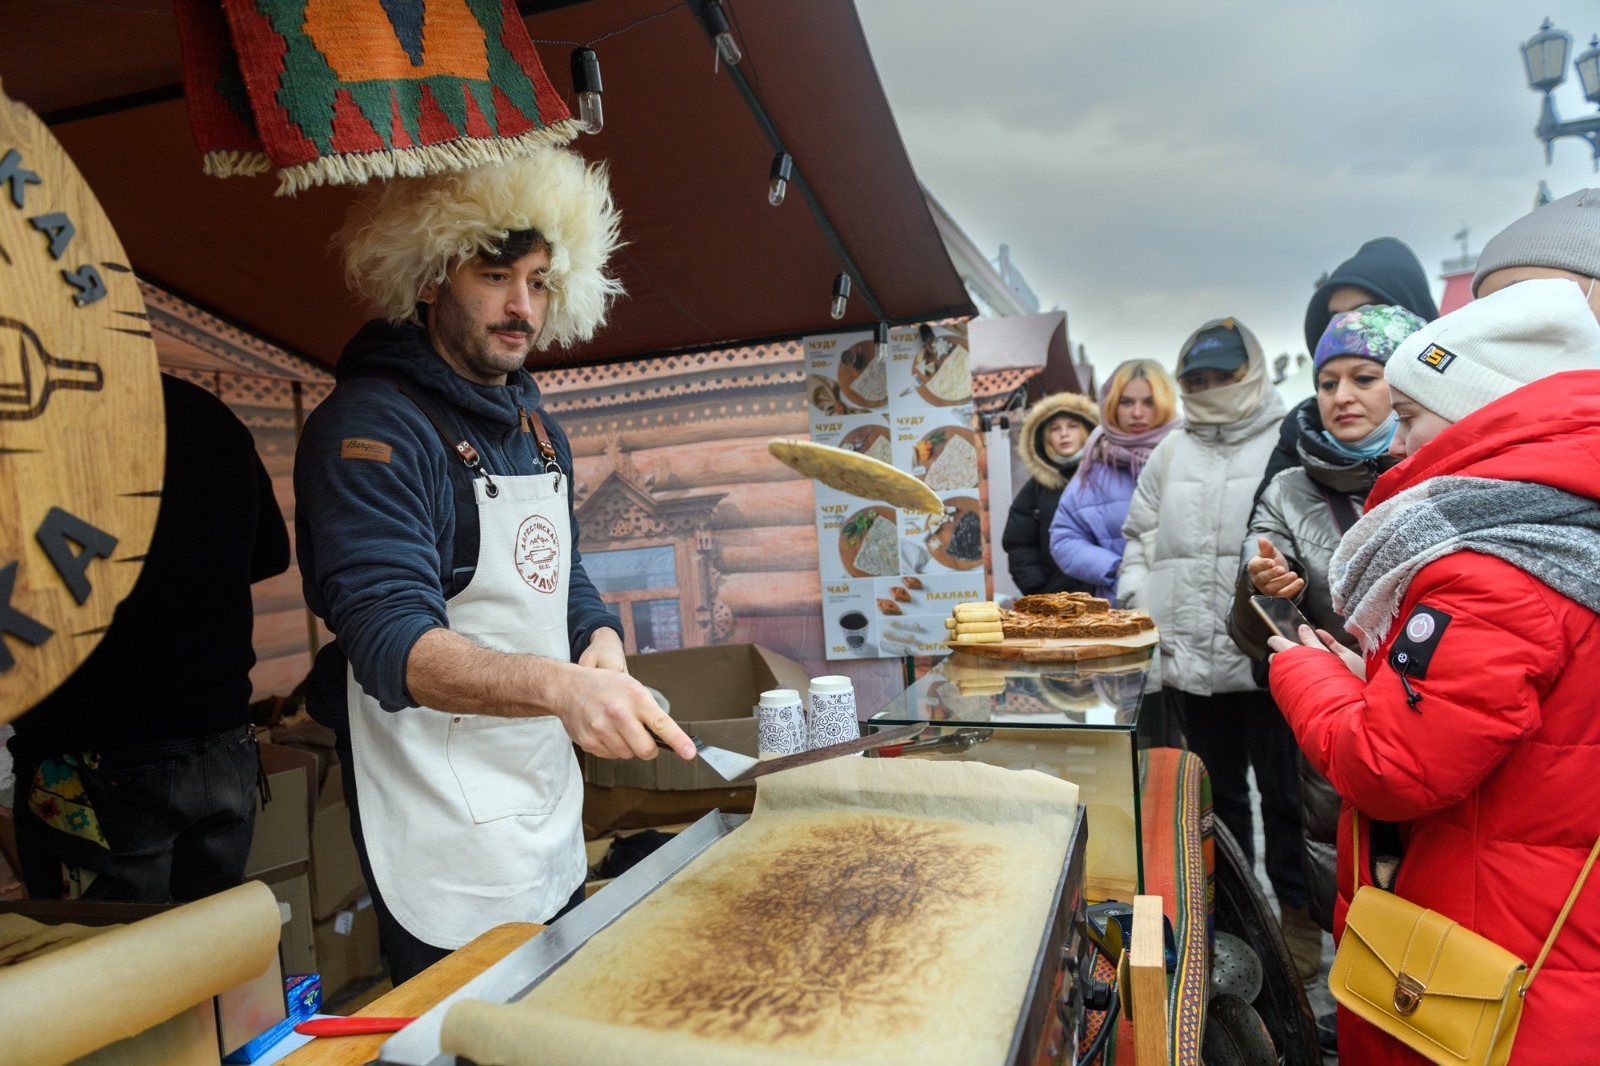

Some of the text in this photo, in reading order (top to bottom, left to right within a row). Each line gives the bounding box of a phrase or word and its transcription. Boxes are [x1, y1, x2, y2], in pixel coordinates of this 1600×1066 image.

[891, 333, 919, 342] ЧУДУ
[809, 340, 837, 349] ЧУДУ
[896, 416, 925, 425] ЧУДУ
[815, 422, 843, 431] ЧУДУ
[821, 504, 849, 513] ЧУДУ
[827, 583, 850, 593] ЧАЙ
[926, 590, 979, 600] ПАХЛАВА
[917, 643, 950, 651] СИГА
